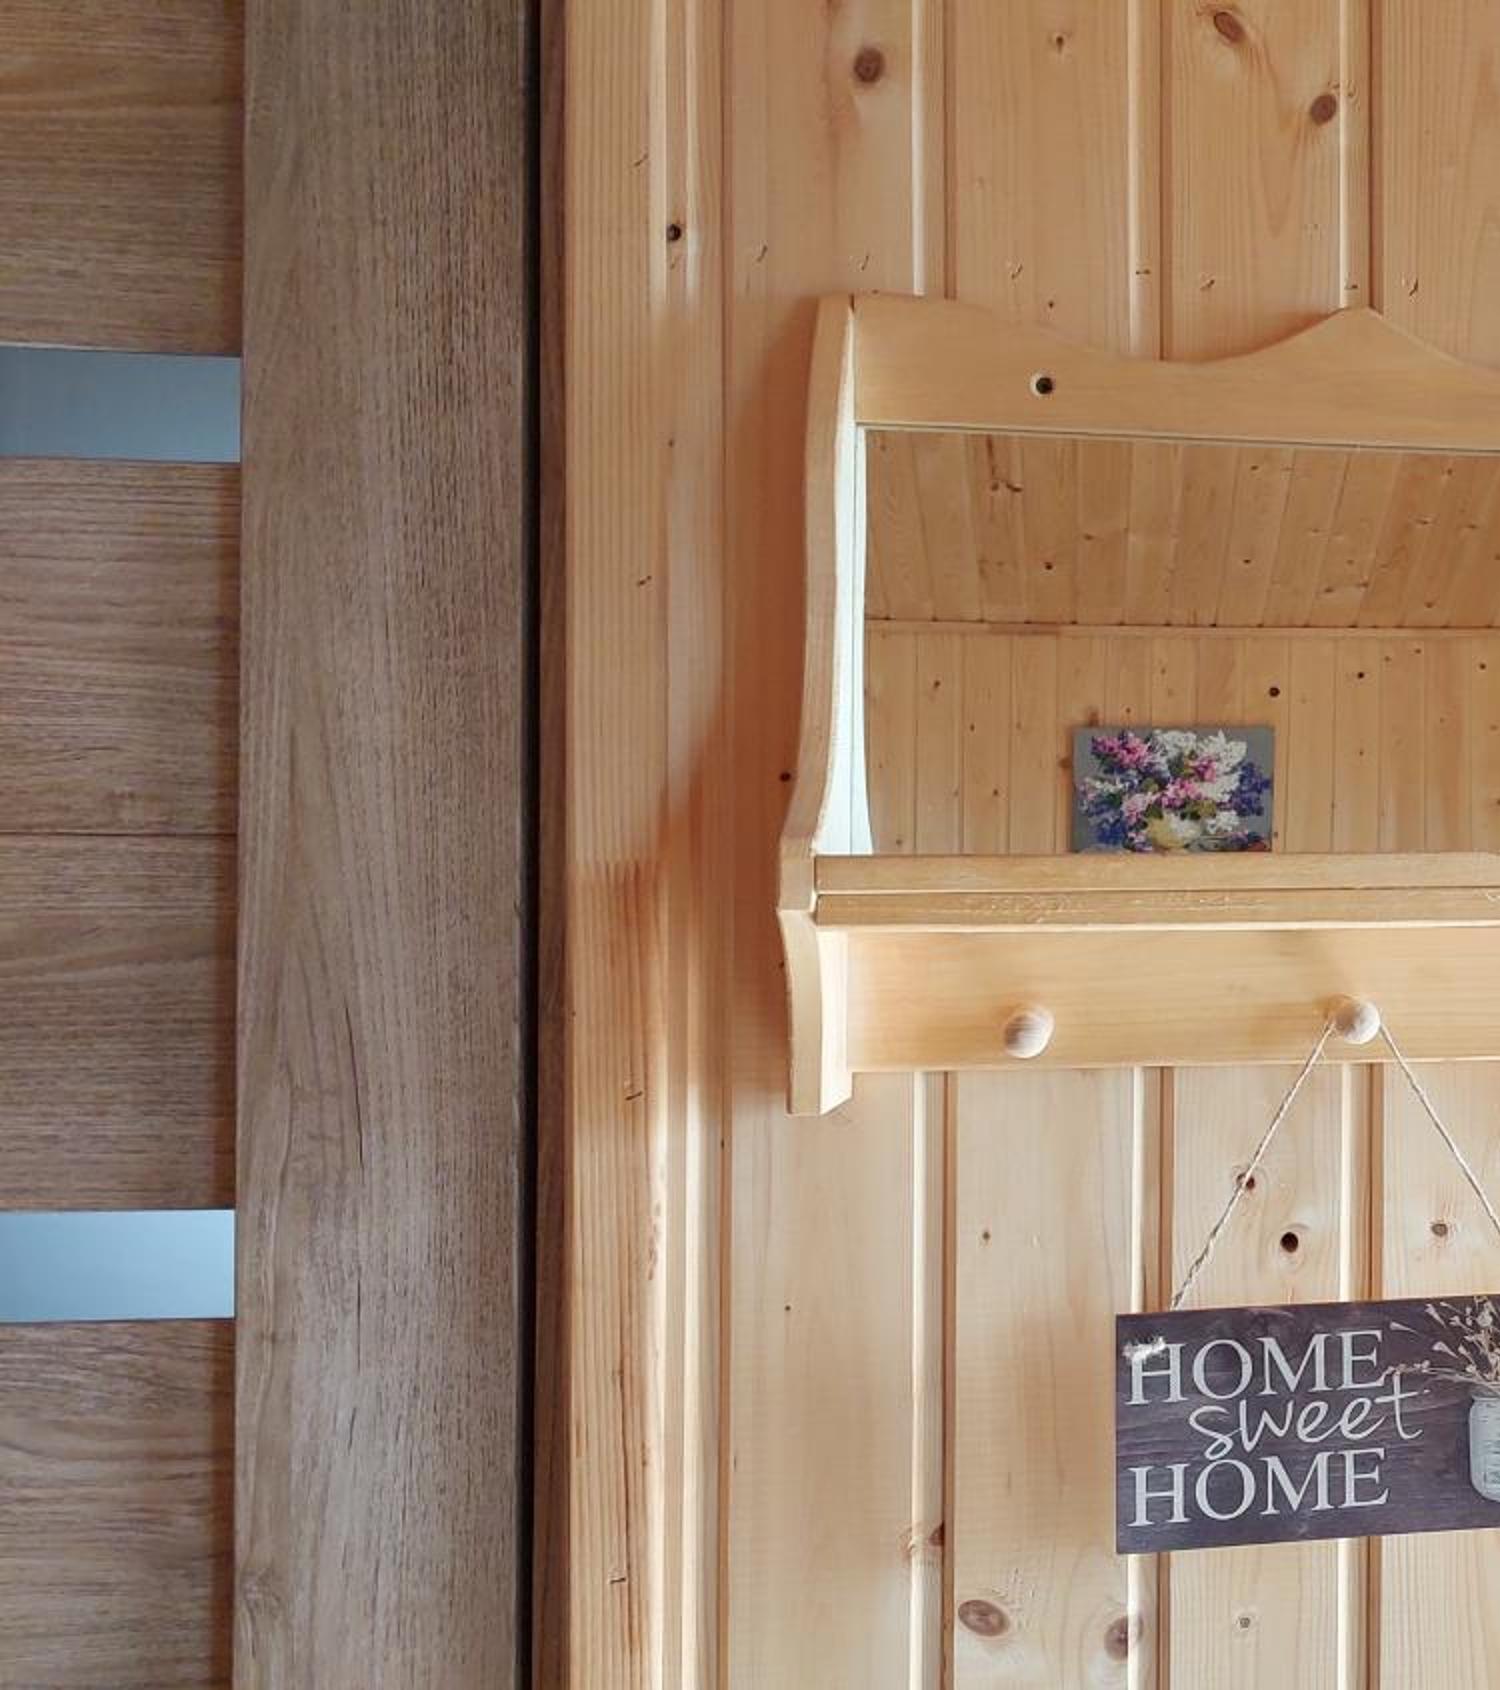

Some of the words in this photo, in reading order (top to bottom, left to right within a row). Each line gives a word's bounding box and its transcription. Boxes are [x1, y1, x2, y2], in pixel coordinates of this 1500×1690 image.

[1125, 1330, 1384, 1405] HOME
[1188, 1373, 1429, 1460] sweet
[1127, 1447, 1389, 1527] HOME
